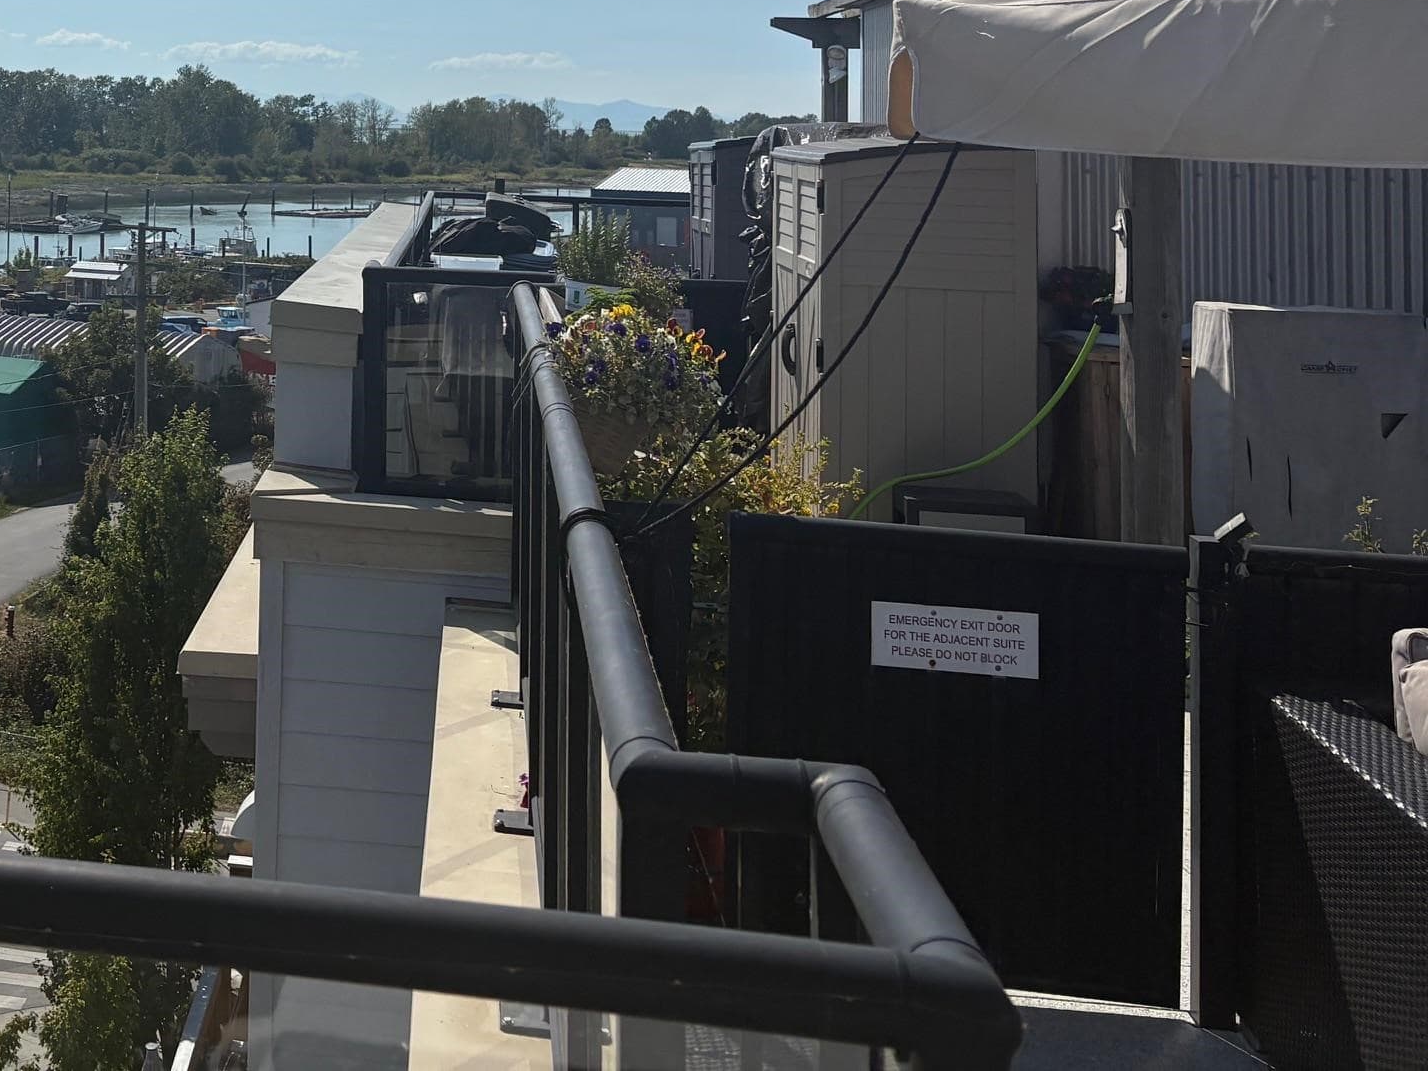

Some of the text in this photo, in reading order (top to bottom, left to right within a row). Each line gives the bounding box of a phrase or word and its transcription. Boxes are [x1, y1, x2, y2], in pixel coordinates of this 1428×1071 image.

[889, 614, 1021, 635] EMERGENCY EXIT DOOR
[884, 629, 1026, 650] FOR THE ADJACENT SUITE
[891, 645, 1018, 666] PLEASE DO NOT BLOCK
